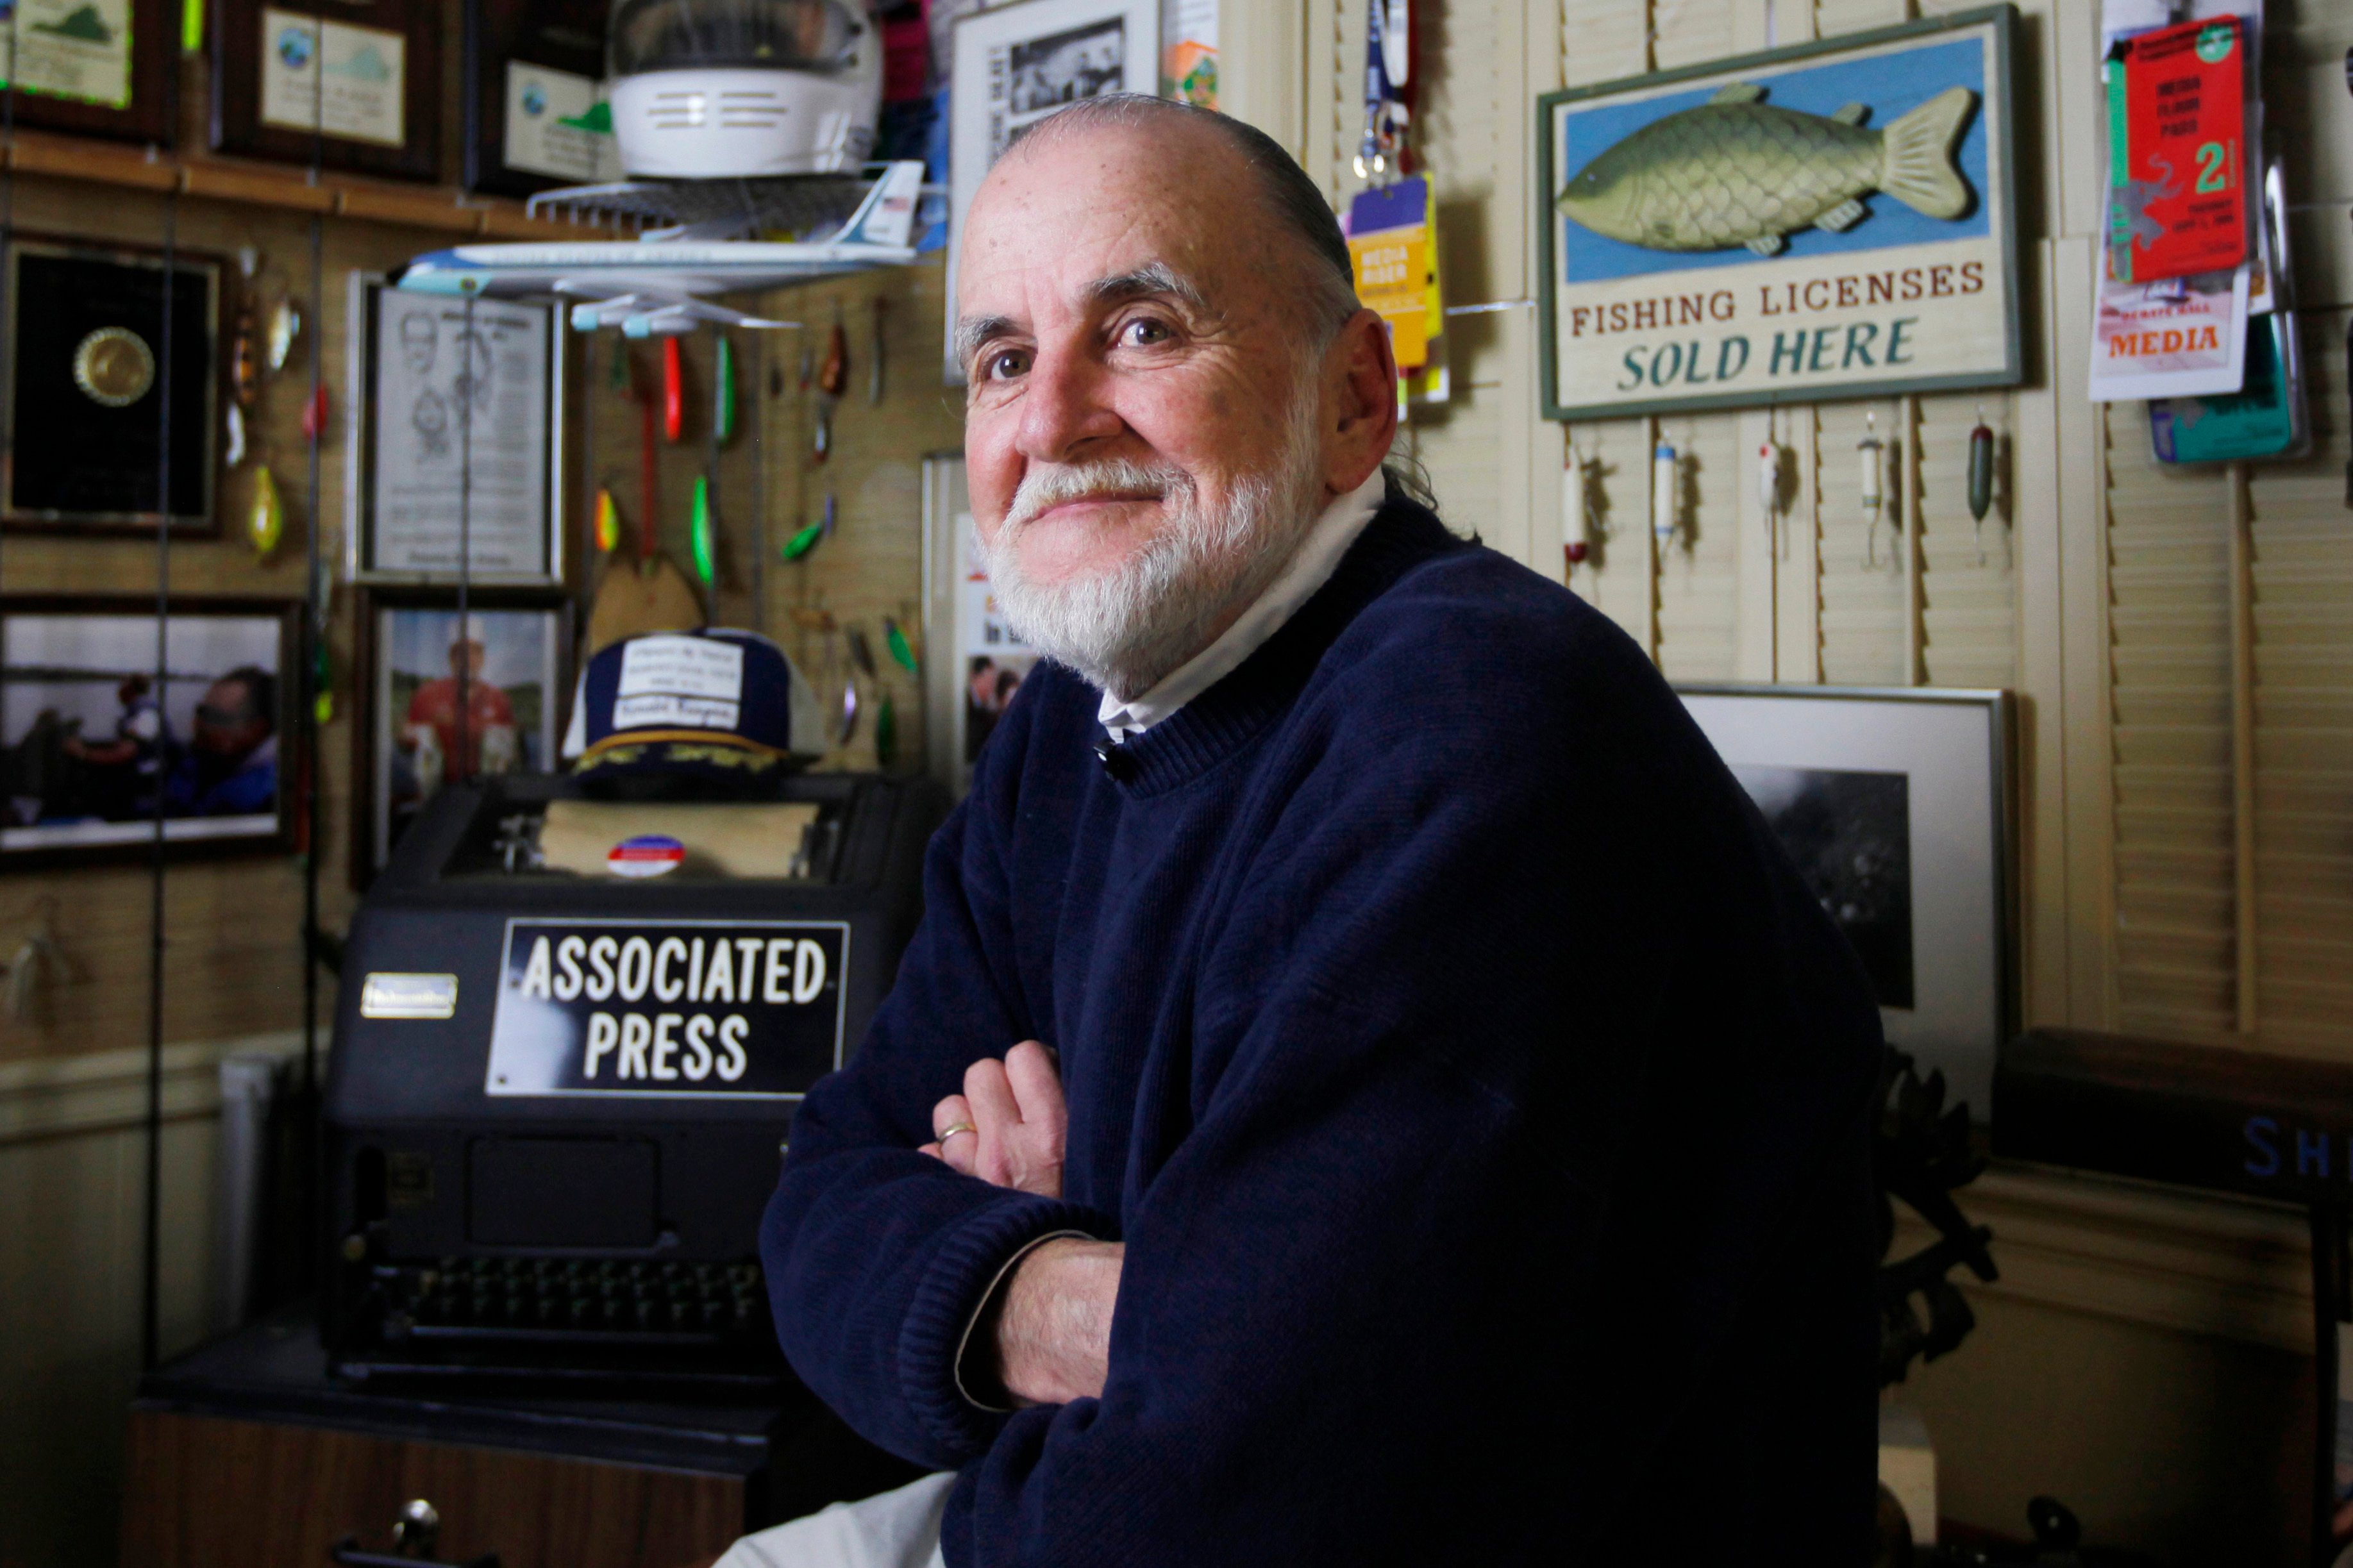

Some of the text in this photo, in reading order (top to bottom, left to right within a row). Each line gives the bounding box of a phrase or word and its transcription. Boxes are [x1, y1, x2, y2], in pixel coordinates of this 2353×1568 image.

[2196, 142, 2225, 194] 2
[1362, 246, 1408, 266] MEDIA
[1571, 262, 1984, 337] FISHING LICENSES
[1618, 317, 1919, 391] SOLD HERE
[2109, 326, 2218, 358] MEDIA
[521, 935, 826, 1005] ASSOCIATED
[583, 1013, 749, 1081] PRESS
[2244, 1116, 2353, 1181] SH
